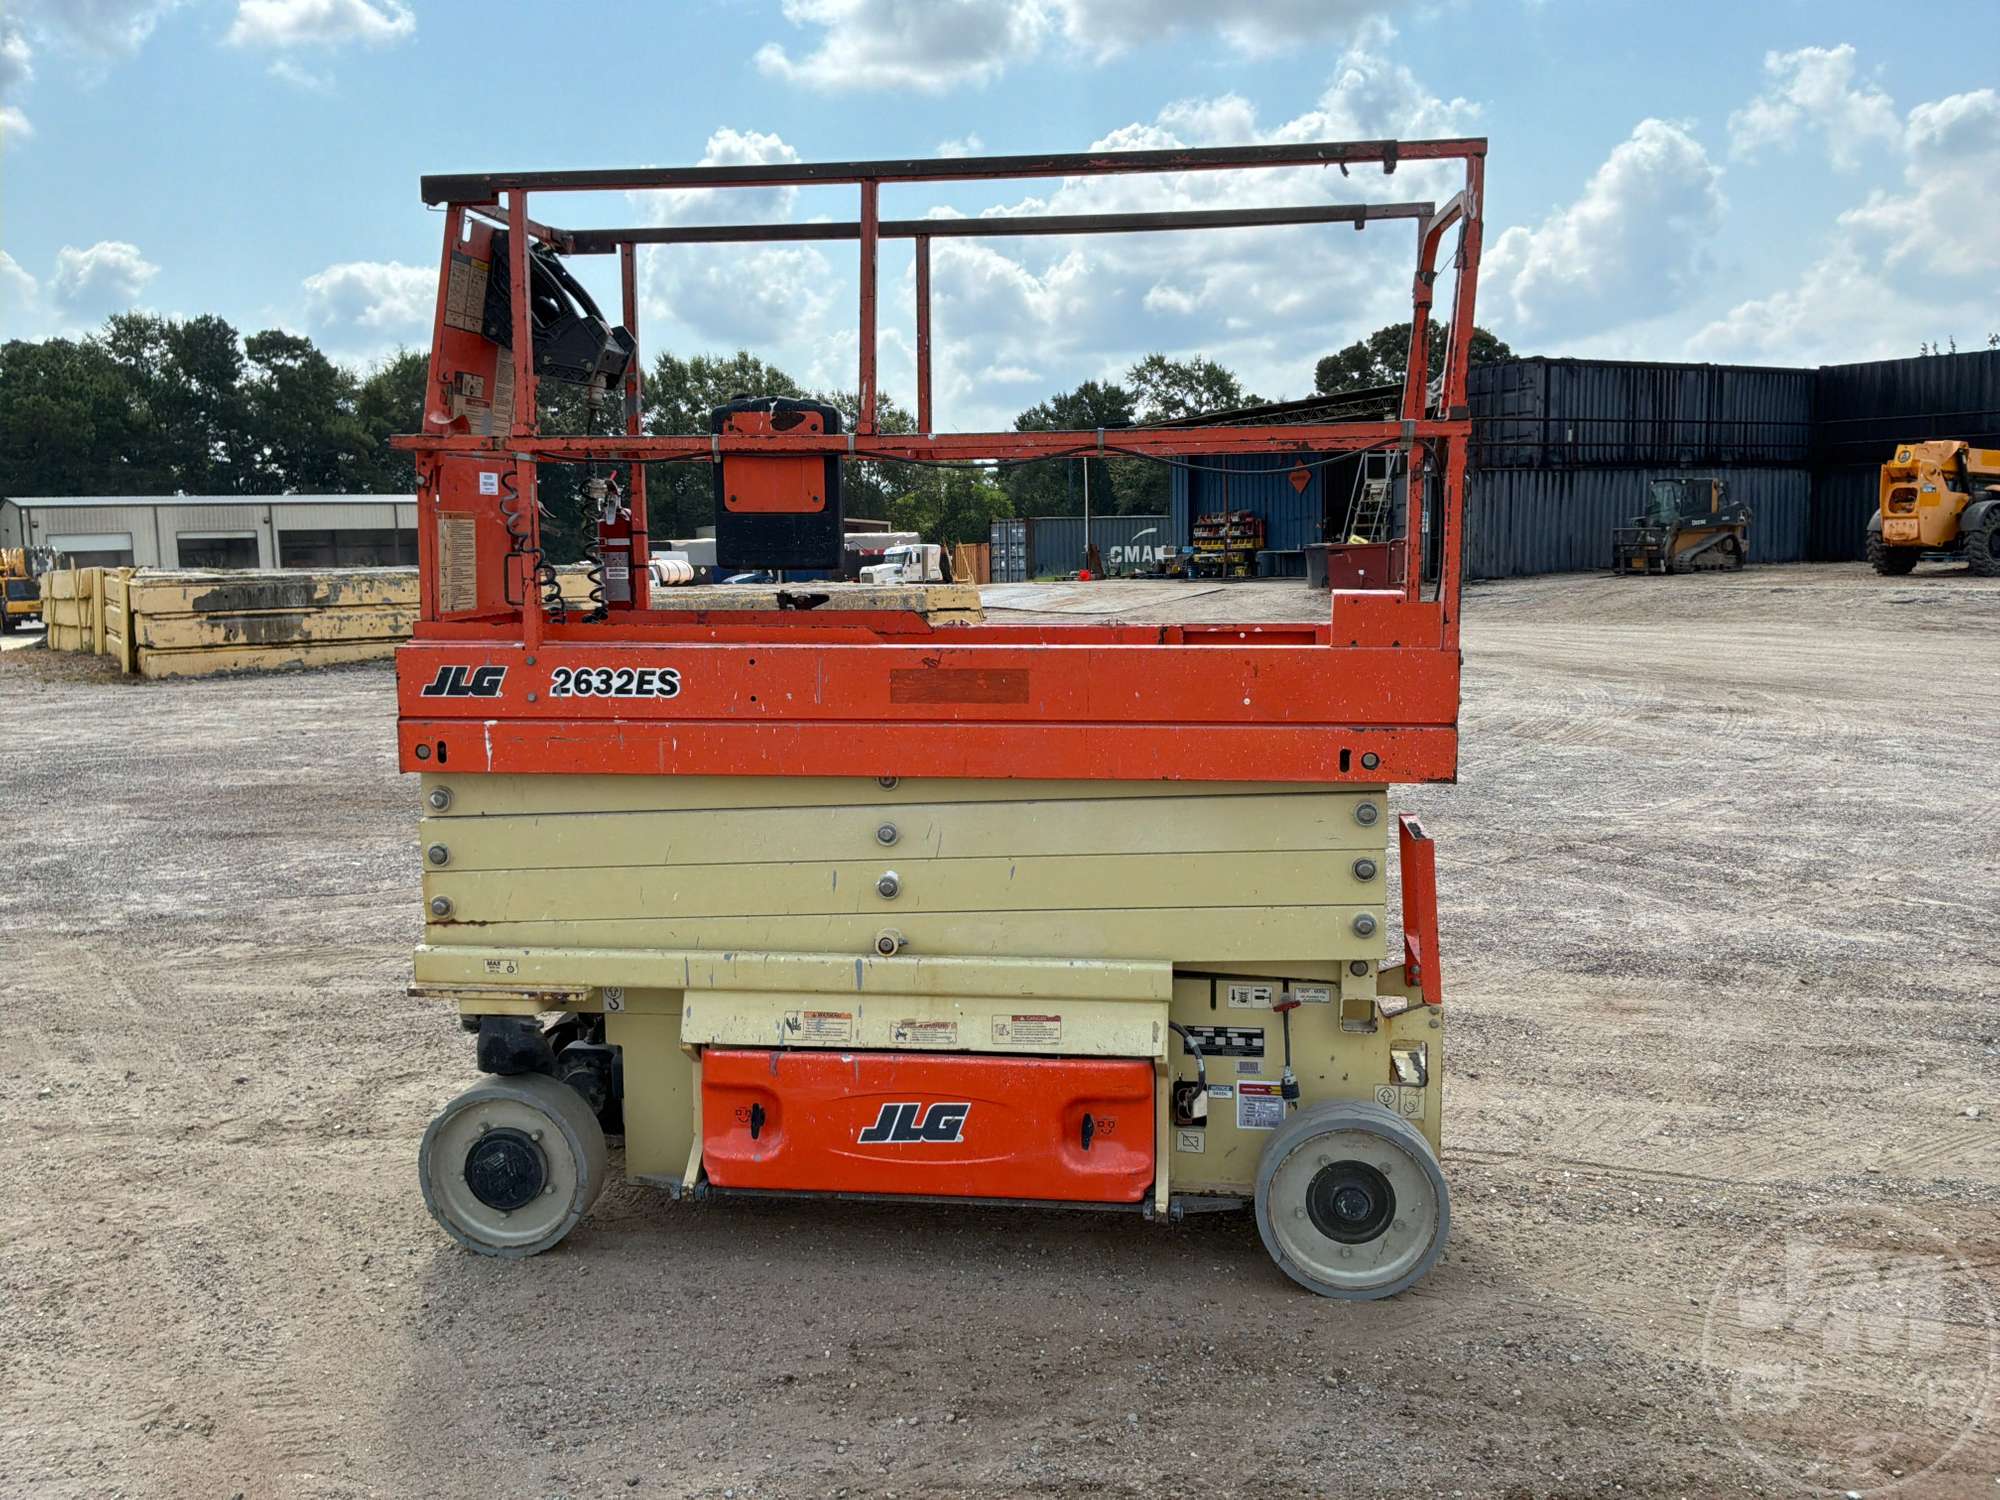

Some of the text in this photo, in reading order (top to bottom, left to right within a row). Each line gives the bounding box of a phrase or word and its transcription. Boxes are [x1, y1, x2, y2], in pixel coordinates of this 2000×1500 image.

[420, 665, 508, 698] JLG
[549, 666, 682, 698] 2632ES
[857, 1102, 972, 1144] JLG
